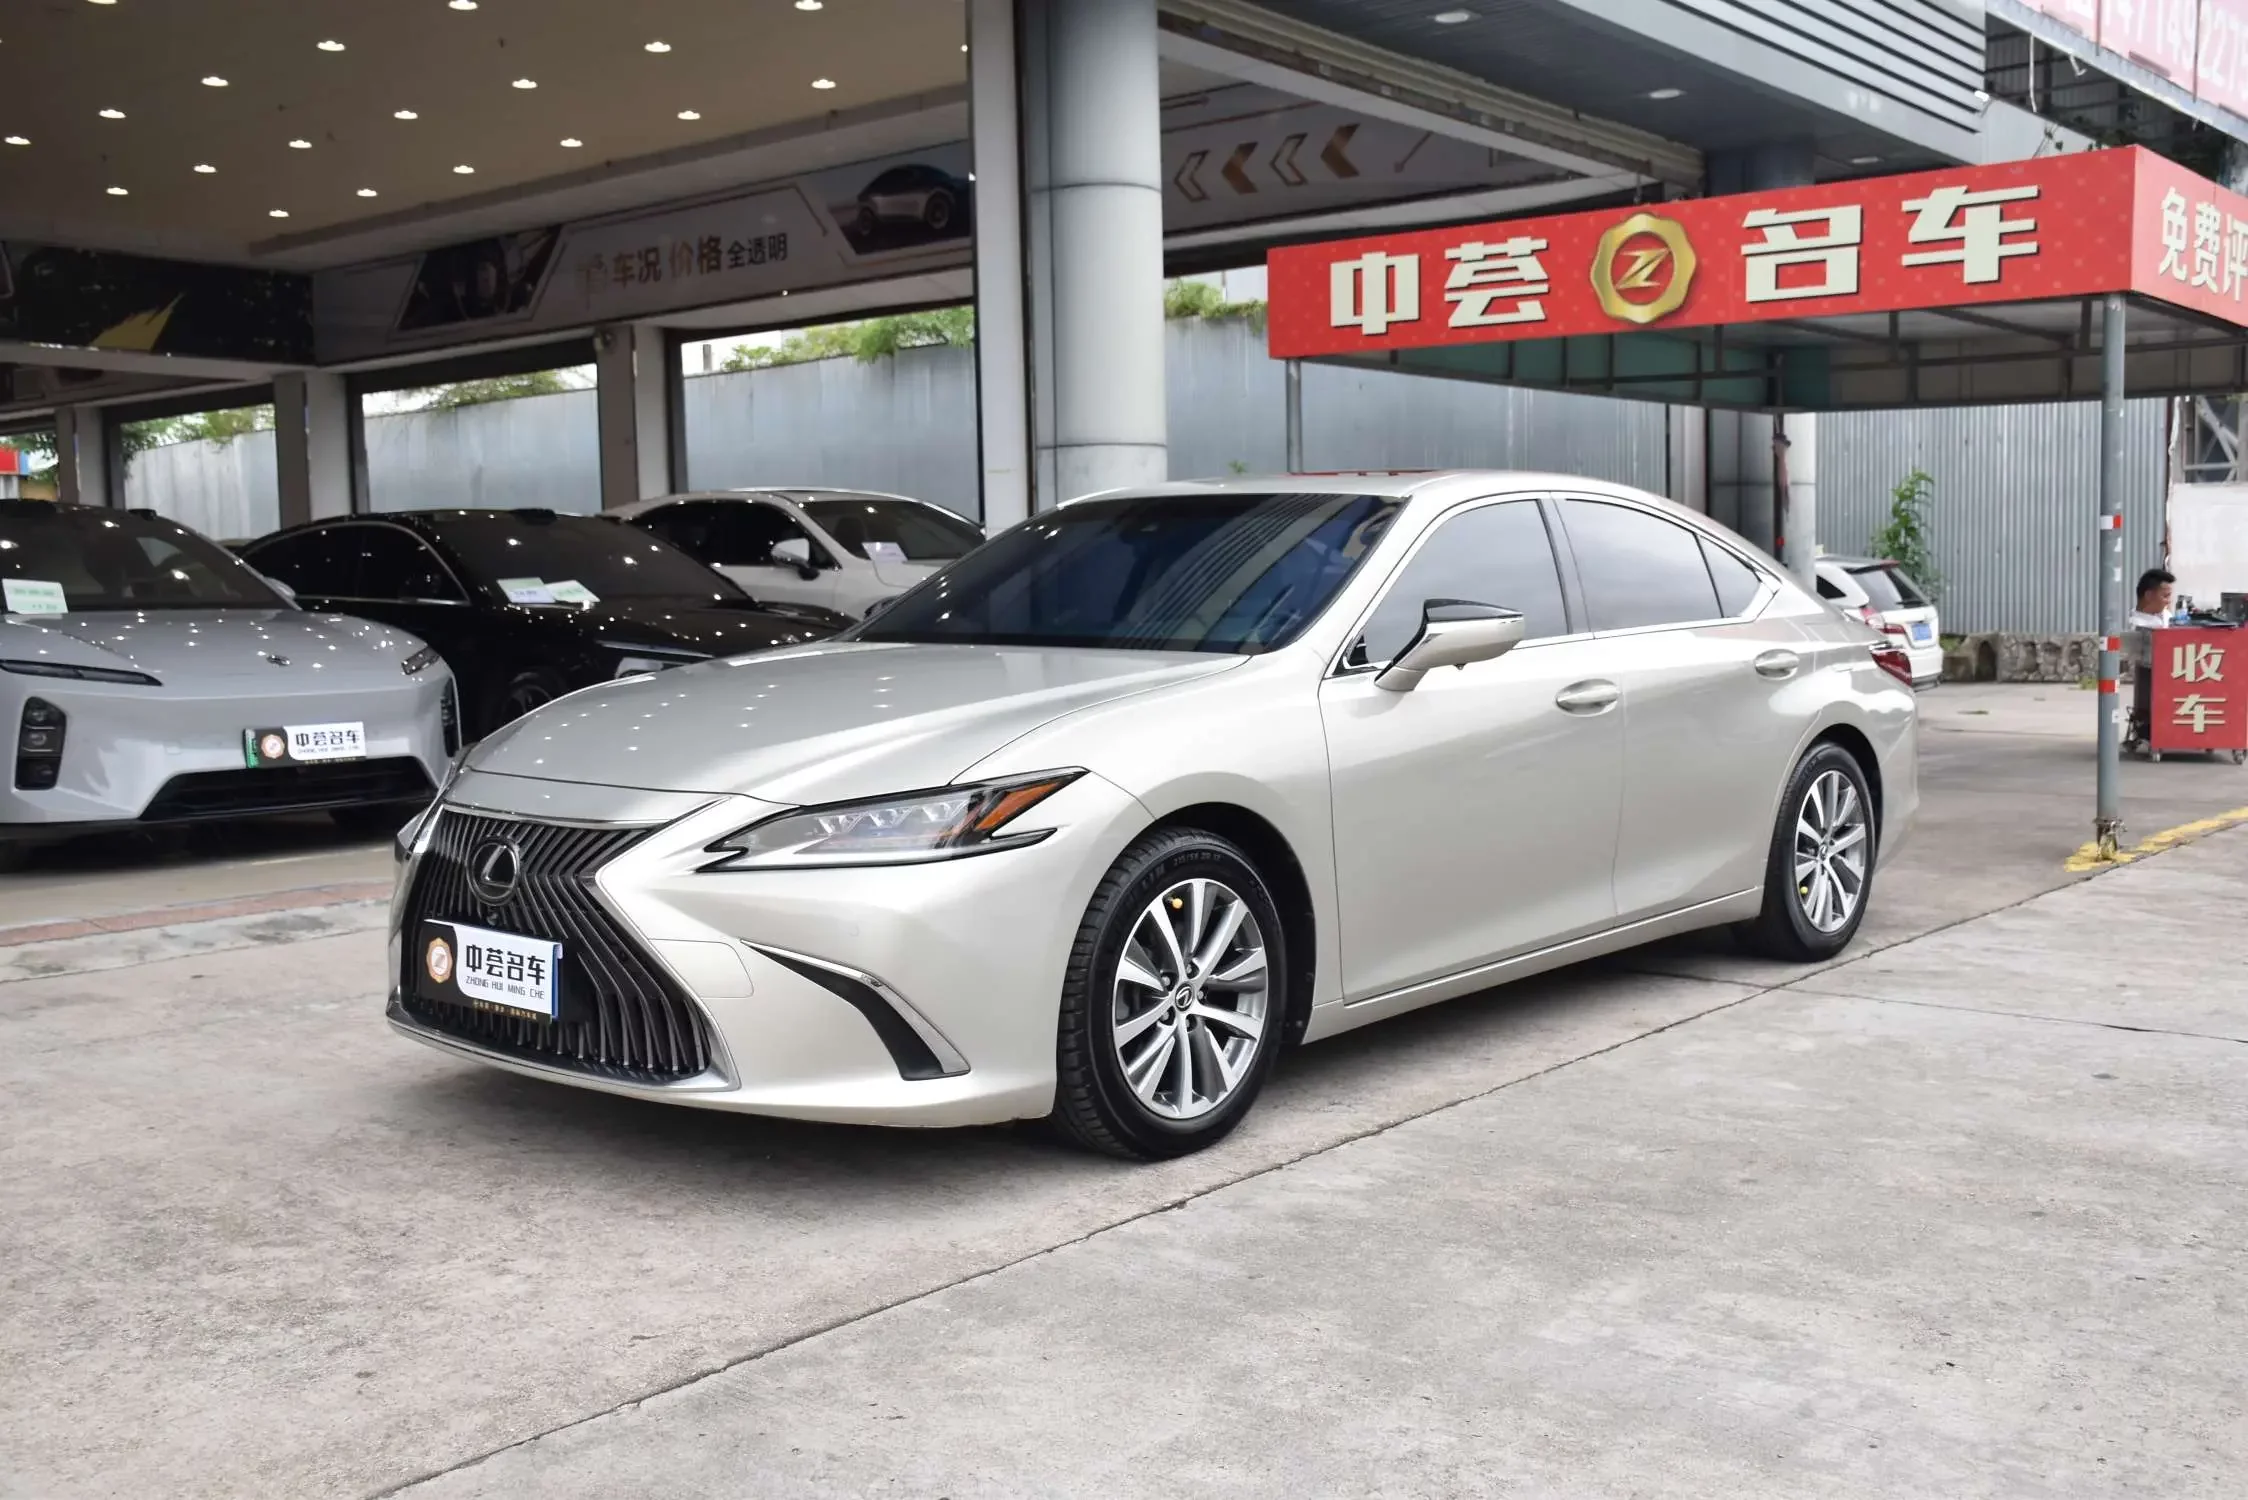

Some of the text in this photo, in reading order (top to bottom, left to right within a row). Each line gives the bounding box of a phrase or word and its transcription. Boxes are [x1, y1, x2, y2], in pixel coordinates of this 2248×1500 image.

[613, 247, 662, 289] 车况
[668, 235, 722, 279] 价格
[728, 232, 788, 269] 全透明
[1330, 236, 1549, 335] 中荟
[1741, 184, 2040, 303] 名车
[2159, 186, 2248, 301] 免费评
[2171, 643, 2227, 733] 收车
[295, 729, 360, 747] 中荟名车
[465, 943, 546, 987] 中荟名车
[465, 976, 545, 1000] ZHONG HUI MING CHE
